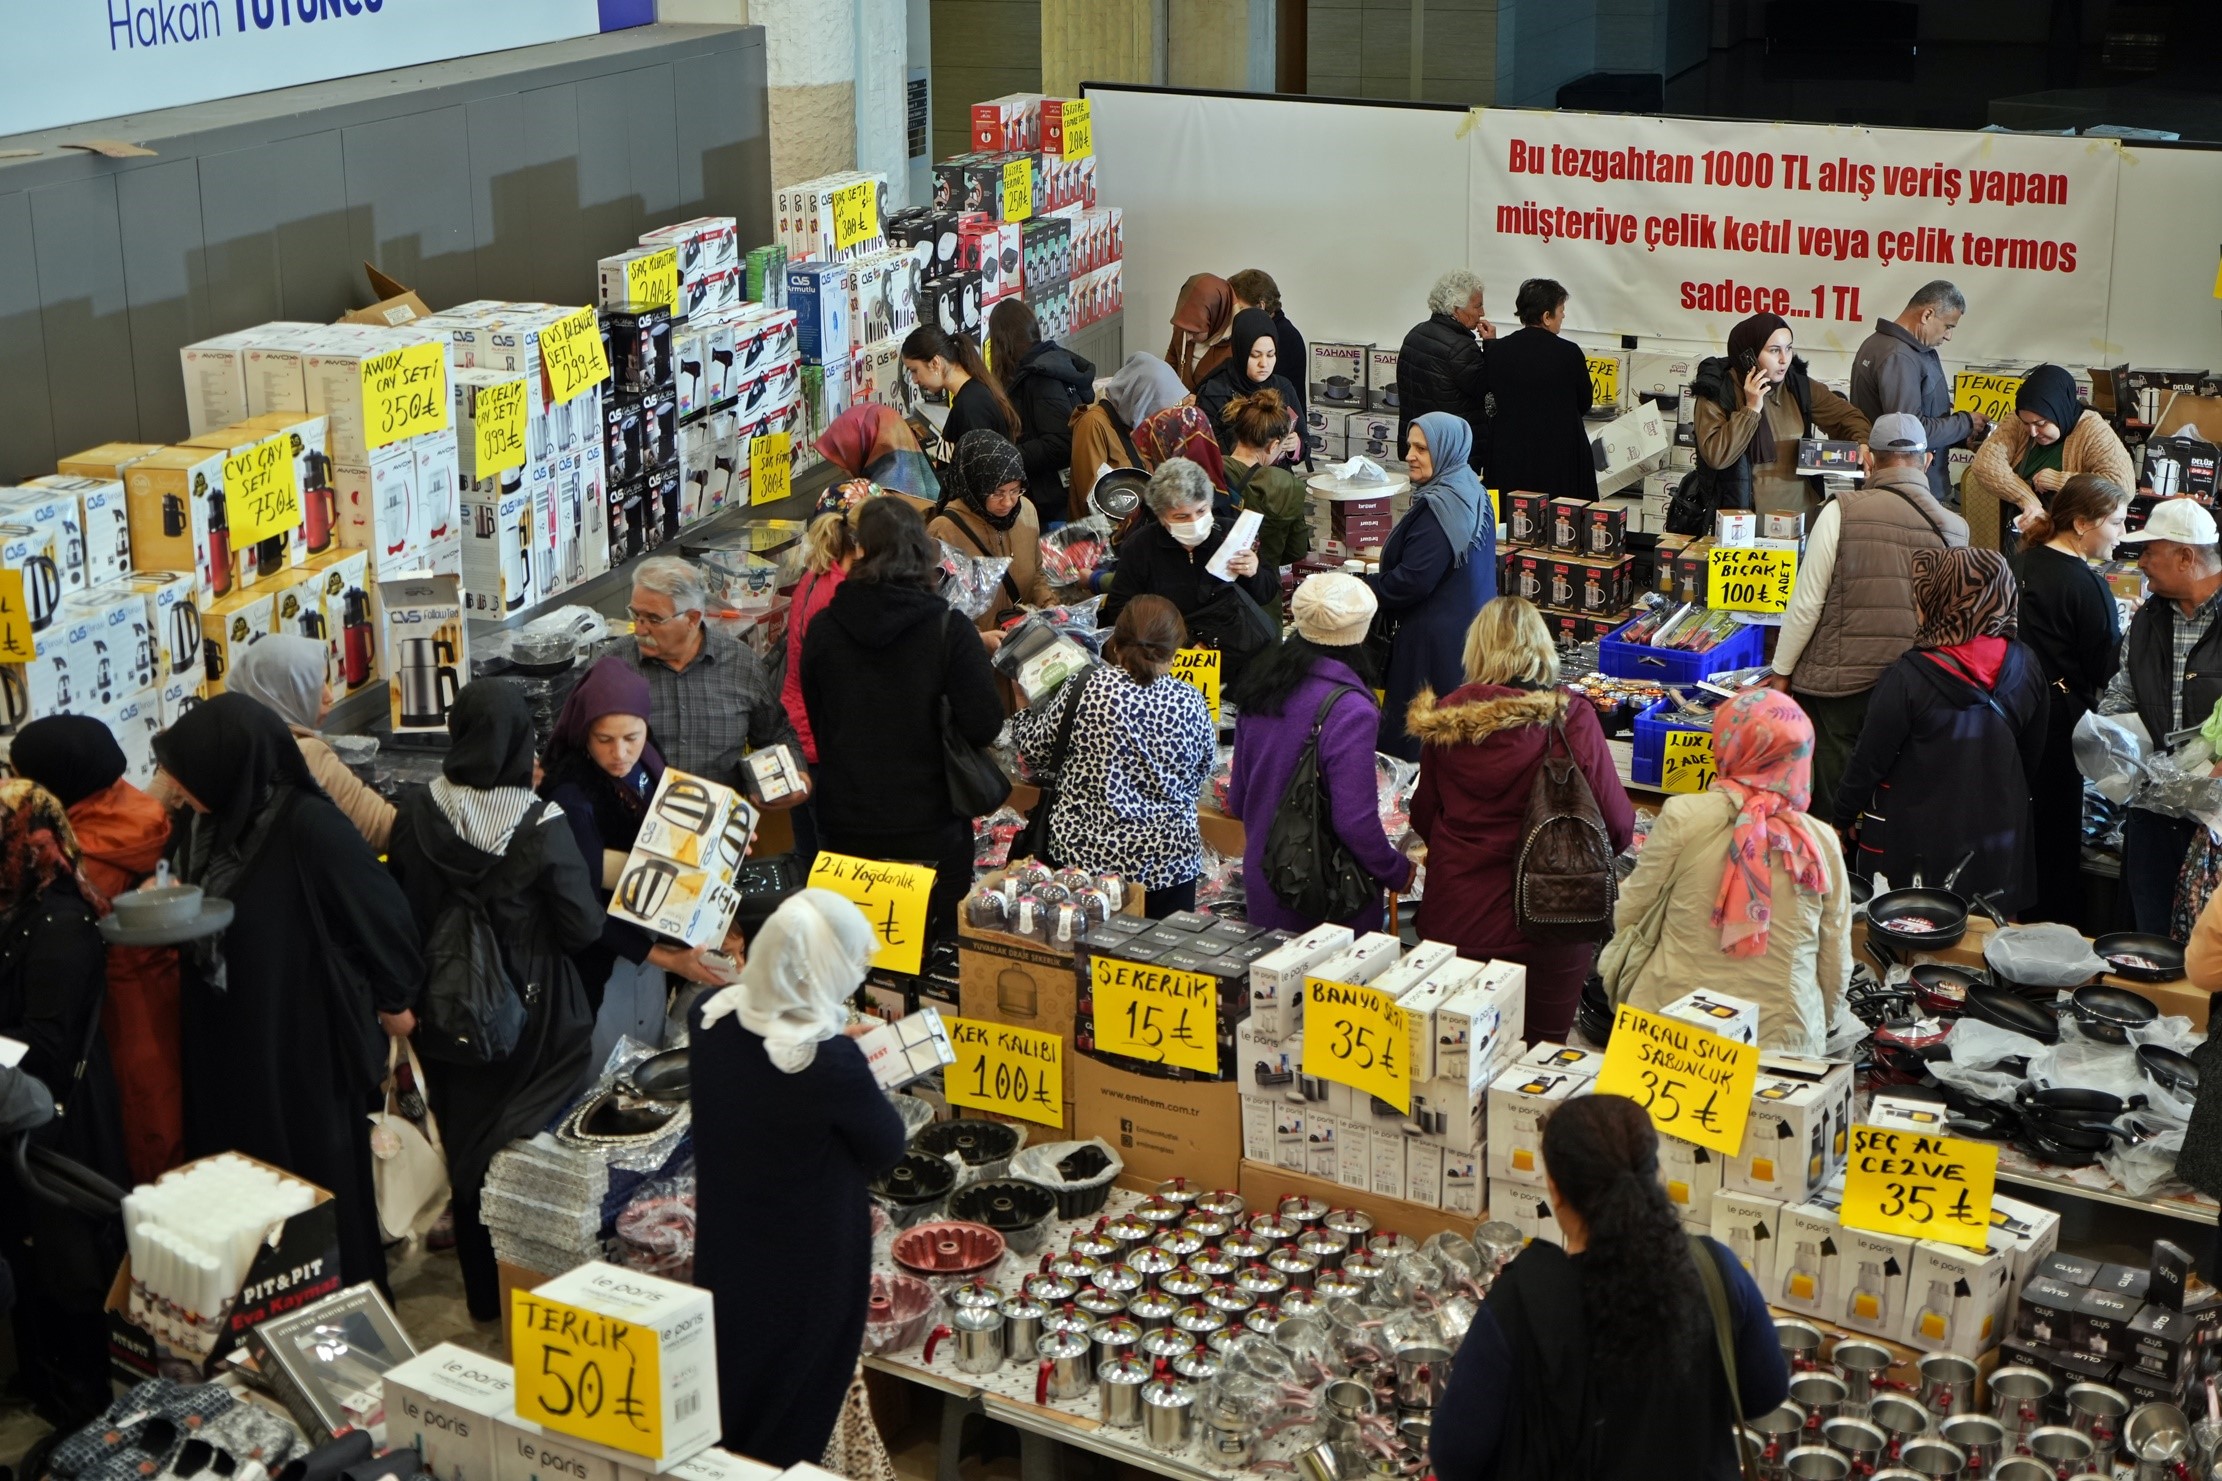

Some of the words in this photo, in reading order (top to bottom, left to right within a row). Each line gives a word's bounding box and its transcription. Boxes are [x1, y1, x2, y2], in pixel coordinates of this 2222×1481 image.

[108, 0, 220, 50] Hakan
[1509, 139, 1544, 174] Bu
[1552, 144, 1694, 184] tezgahtan
[1701, 151, 1773, 188] 1000
[1781, 155, 1811, 190] TL
[1819, 158, 1875, 201] alış
[1883, 162, 1962, 206] veriş
[1969, 170, 2068, 206] yapan
[1496, 201, 1637, 245] müşteriye
[1645, 213, 1717, 251] çelik
[1724, 216, 1791, 254] ketıl
[1798, 226, 1869, 260] veya
[1877, 227, 1954, 267] çelik
[1962, 232, 2077, 273] termos
[1832, 286, 1862, 322] TL
[364, 352, 407, 383] AWOX
[1315, 348, 1360, 358] SAHANE
[402, 358, 439, 385] SETİ
[225, 459, 252, 481] CVS
[241, 463, 272, 498] SETİ
[1721, 565, 1776, 578] BIÇAK
[1748, 552, 1770, 562] AL
[390, 610, 422, 624] CVS
[1669, 734, 1702, 747] LUX
[1098, 960, 1208, 1008] ŞEKERLİK
[1313, 982, 1378, 1012] BANYO
[952, 1022, 988, 1047] KEK
[998, 1032, 1057, 1064] KALIBI
[1692, 1039, 1738, 1066] SIVI
[1637, 1043, 1735, 1096] SABUNLUK
[1100, 1087, 1200, 1117] www.eminem.com.tr
[1911, 1137, 1950, 1157] AL
[1738, 1208, 1762, 1220] paris
[1807, 1221, 1830, 1234] paris
[1869, 1242, 1894, 1255] paris
[243, 1258, 324, 1304] PIT&PIT
[1941, 1259, 1966, 1275] paris
[591, 1275, 607, 1289] le
[612, 1281, 665, 1303] paris
[517, 1302, 636, 1365] TERLİK
[673, 1312, 705, 1337] paris
[442, 1359, 462, 1373] le
[460, 1369, 512, 1391] paris
[403, 1397, 420, 1418] le
[424, 1407, 471, 1439] paris
[517, 1437, 534, 1459] le
[539, 1449, 588, 1480] paris
